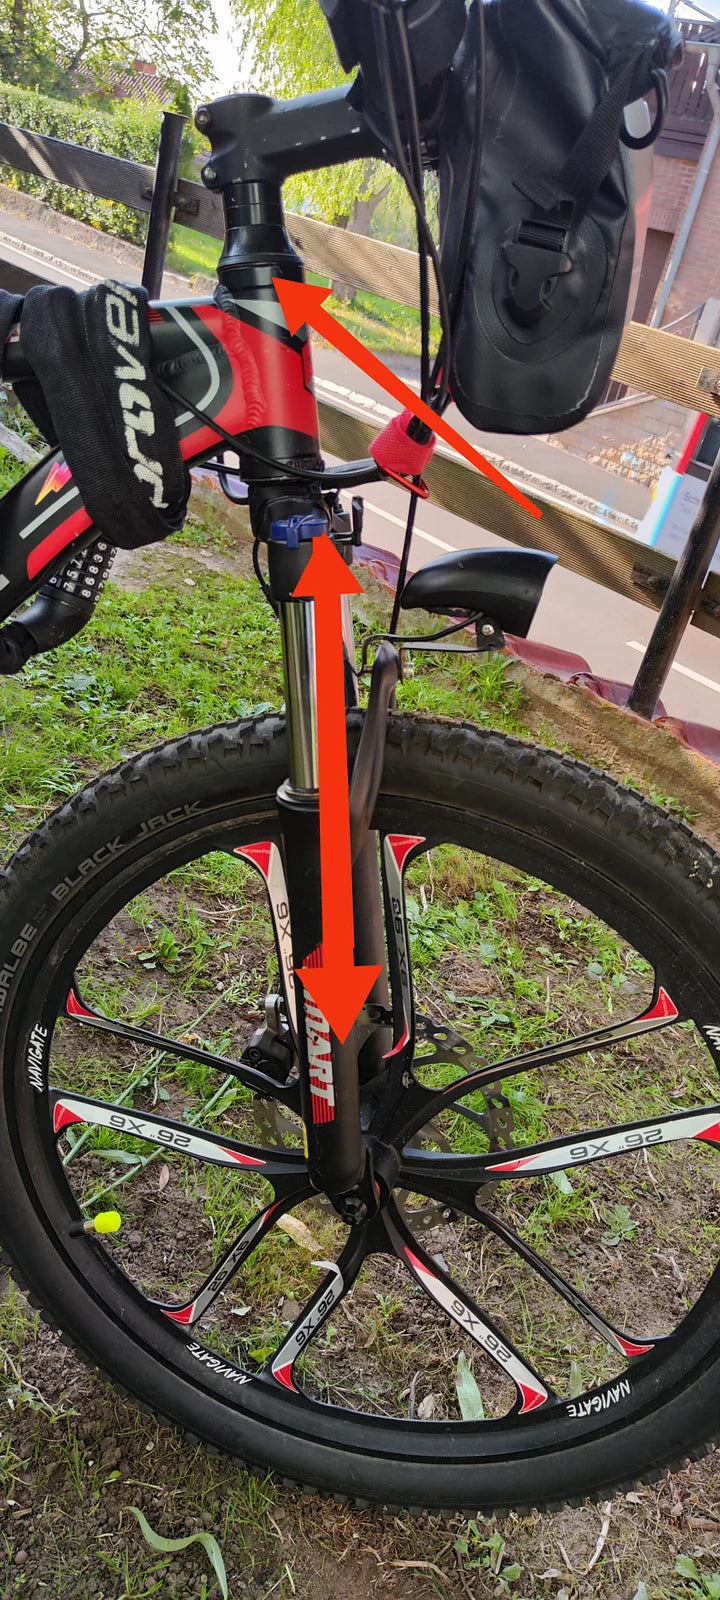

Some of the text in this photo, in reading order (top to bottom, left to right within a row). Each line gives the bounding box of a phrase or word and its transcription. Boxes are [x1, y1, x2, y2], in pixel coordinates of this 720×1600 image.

[51, 835, 125, 901] BLACK
[137, 800, 201, 837] JACK
[27, 1023, 48, 1092] NAVIGATE
[185, 1342, 253, 1385] NAVIGATE
[566, 1379, 632, 1418] NAVIGATE
